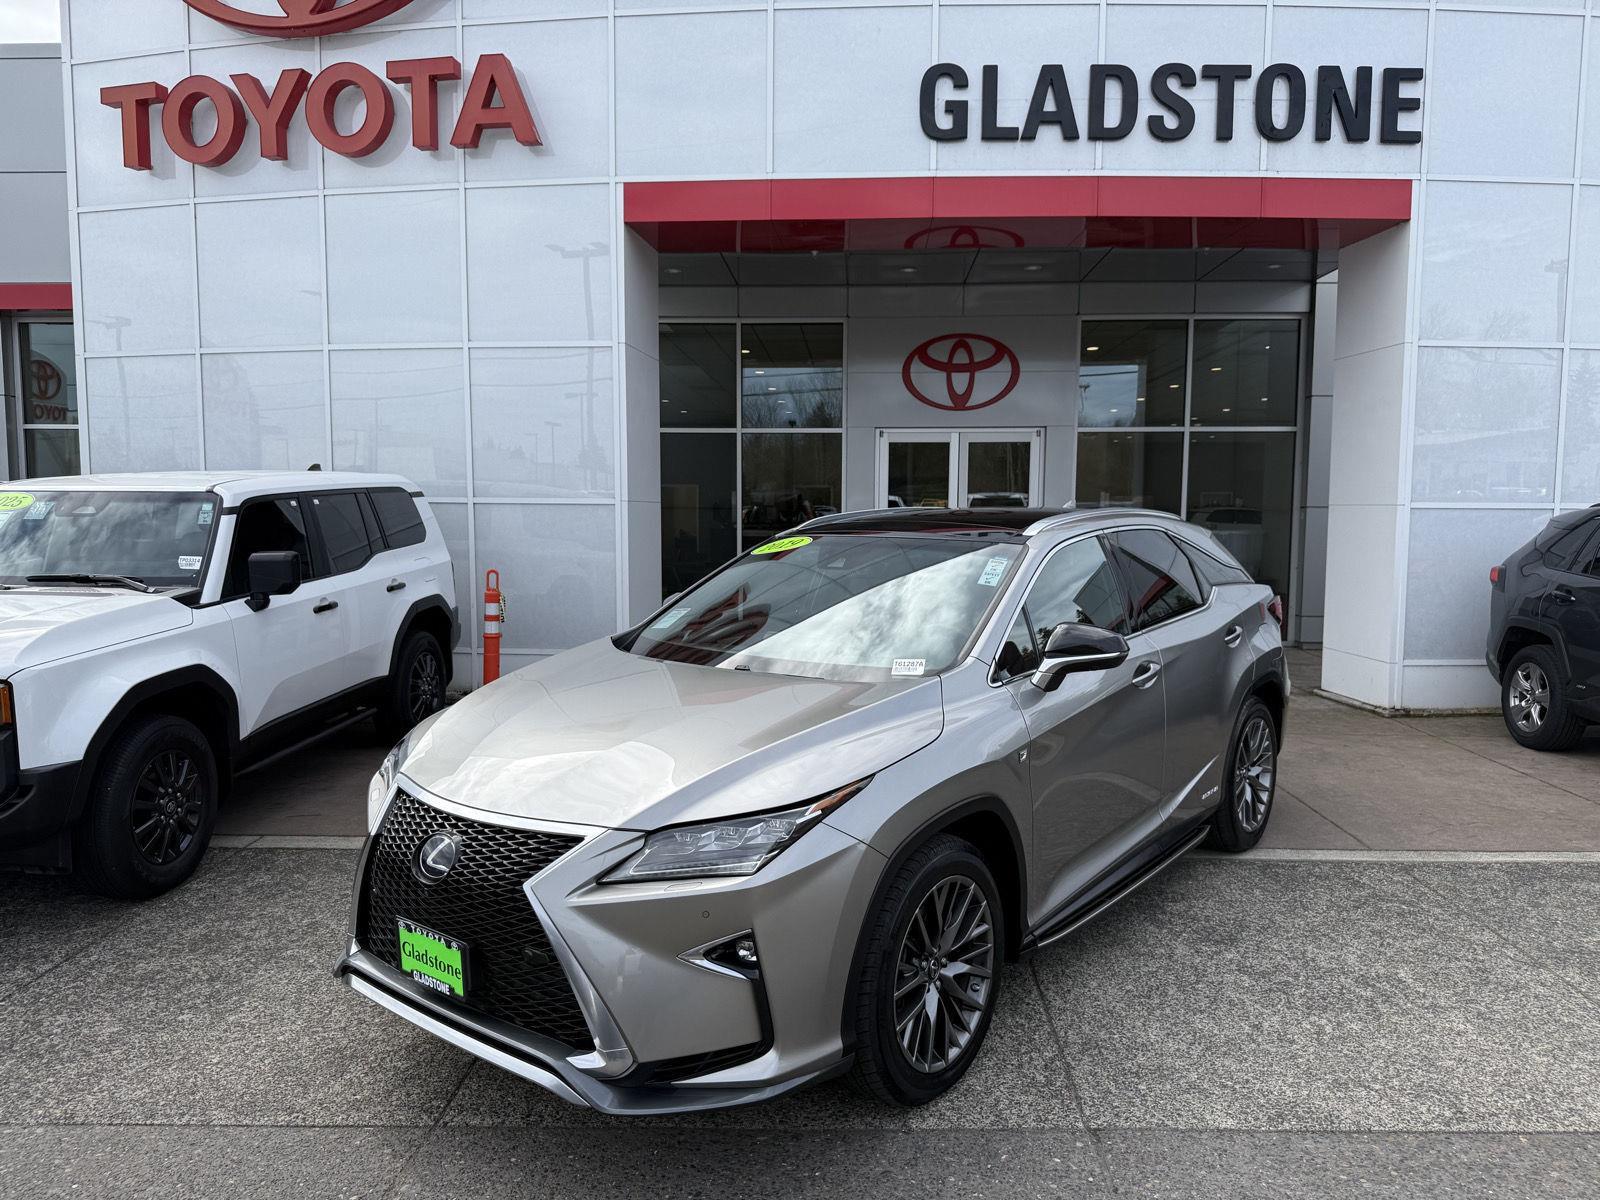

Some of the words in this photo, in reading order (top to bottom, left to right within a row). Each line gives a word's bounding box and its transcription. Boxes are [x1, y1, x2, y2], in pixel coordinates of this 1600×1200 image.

[100, 53, 543, 170] TOYOTA
[919, 63, 1423, 144] GLADSTONE
[0, 496, 28, 508] 025
[410, 925, 446, 945] TOYOTA
[401, 941, 462, 980] Gladstone
[413, 970, 451, 996] GLADSTONE
